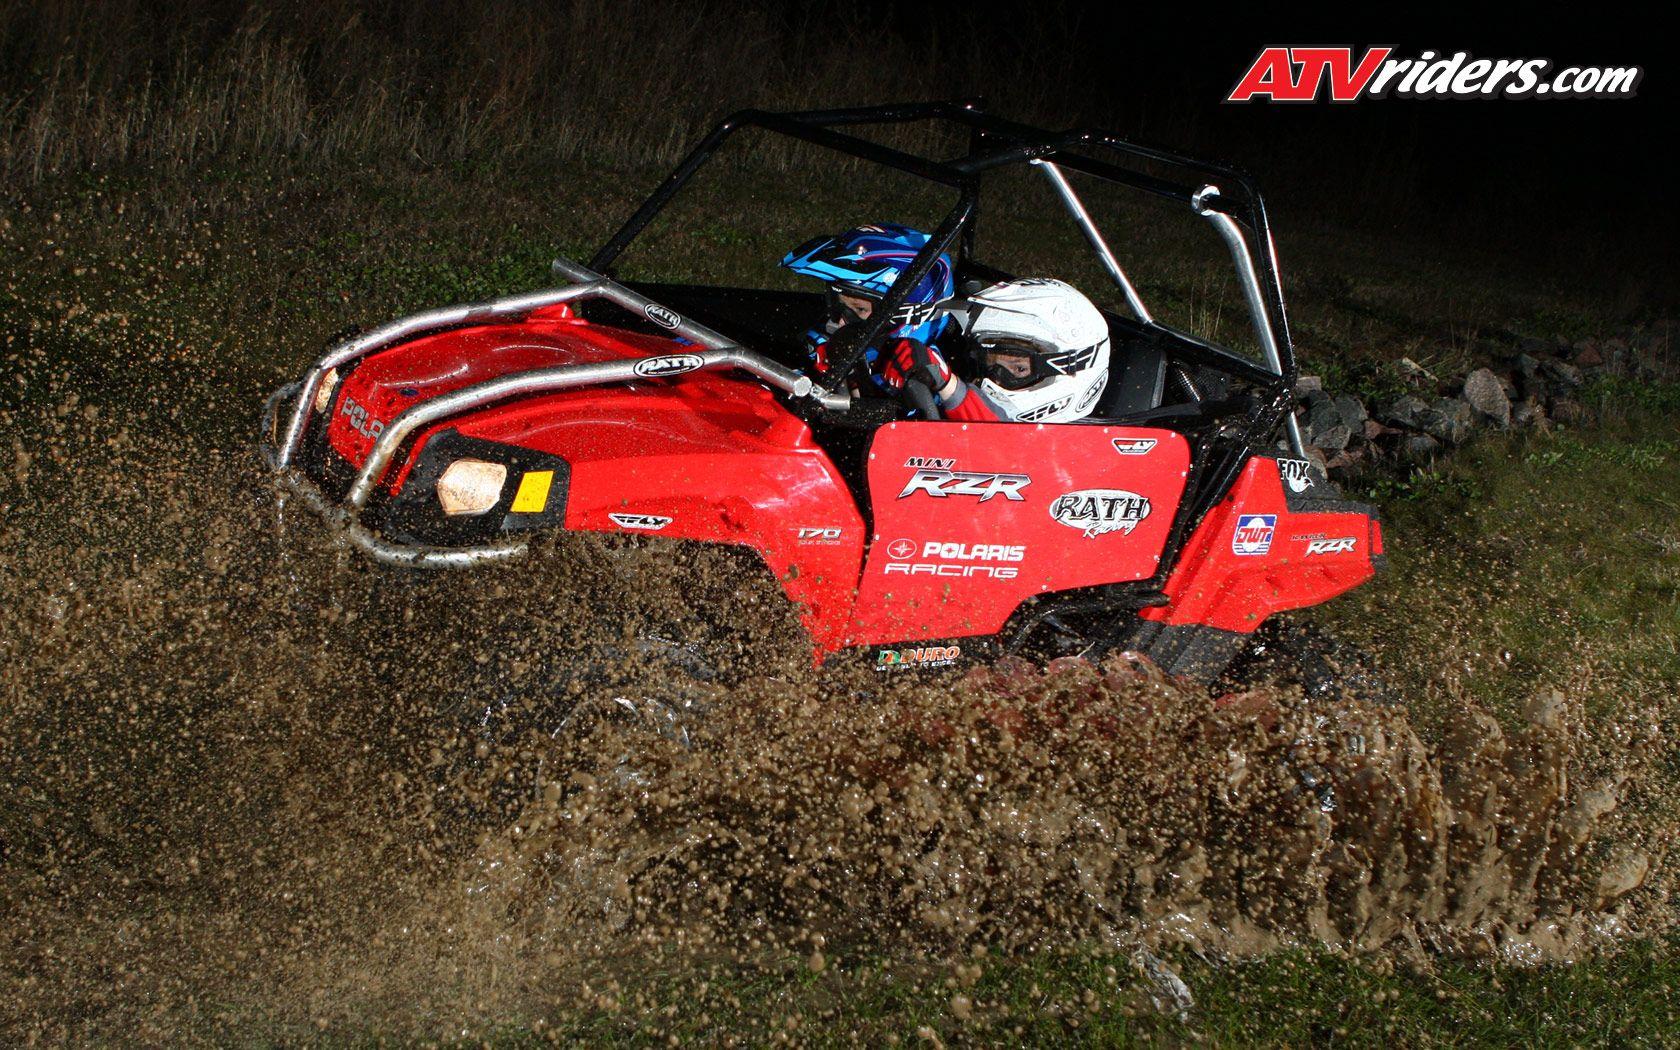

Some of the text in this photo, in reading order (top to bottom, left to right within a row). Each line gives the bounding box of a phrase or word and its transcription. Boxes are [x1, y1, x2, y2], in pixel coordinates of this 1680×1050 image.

[646, 305, 679, 326] RATH
[637, 357, 699, 374] RATH
[904, 457, 956, 469] MINI
[1277, 458, 1310, 480] FOX
[897, 468, 1032, 503] RZR
[1055, 494, 1150, 521] RATH
[798, 527, 843, 539] 170
[922, 541, 1026, 561] POLARIS
[1304, 537, 1357, 558] RZR
[884, 563, 1019, 578] RACING
